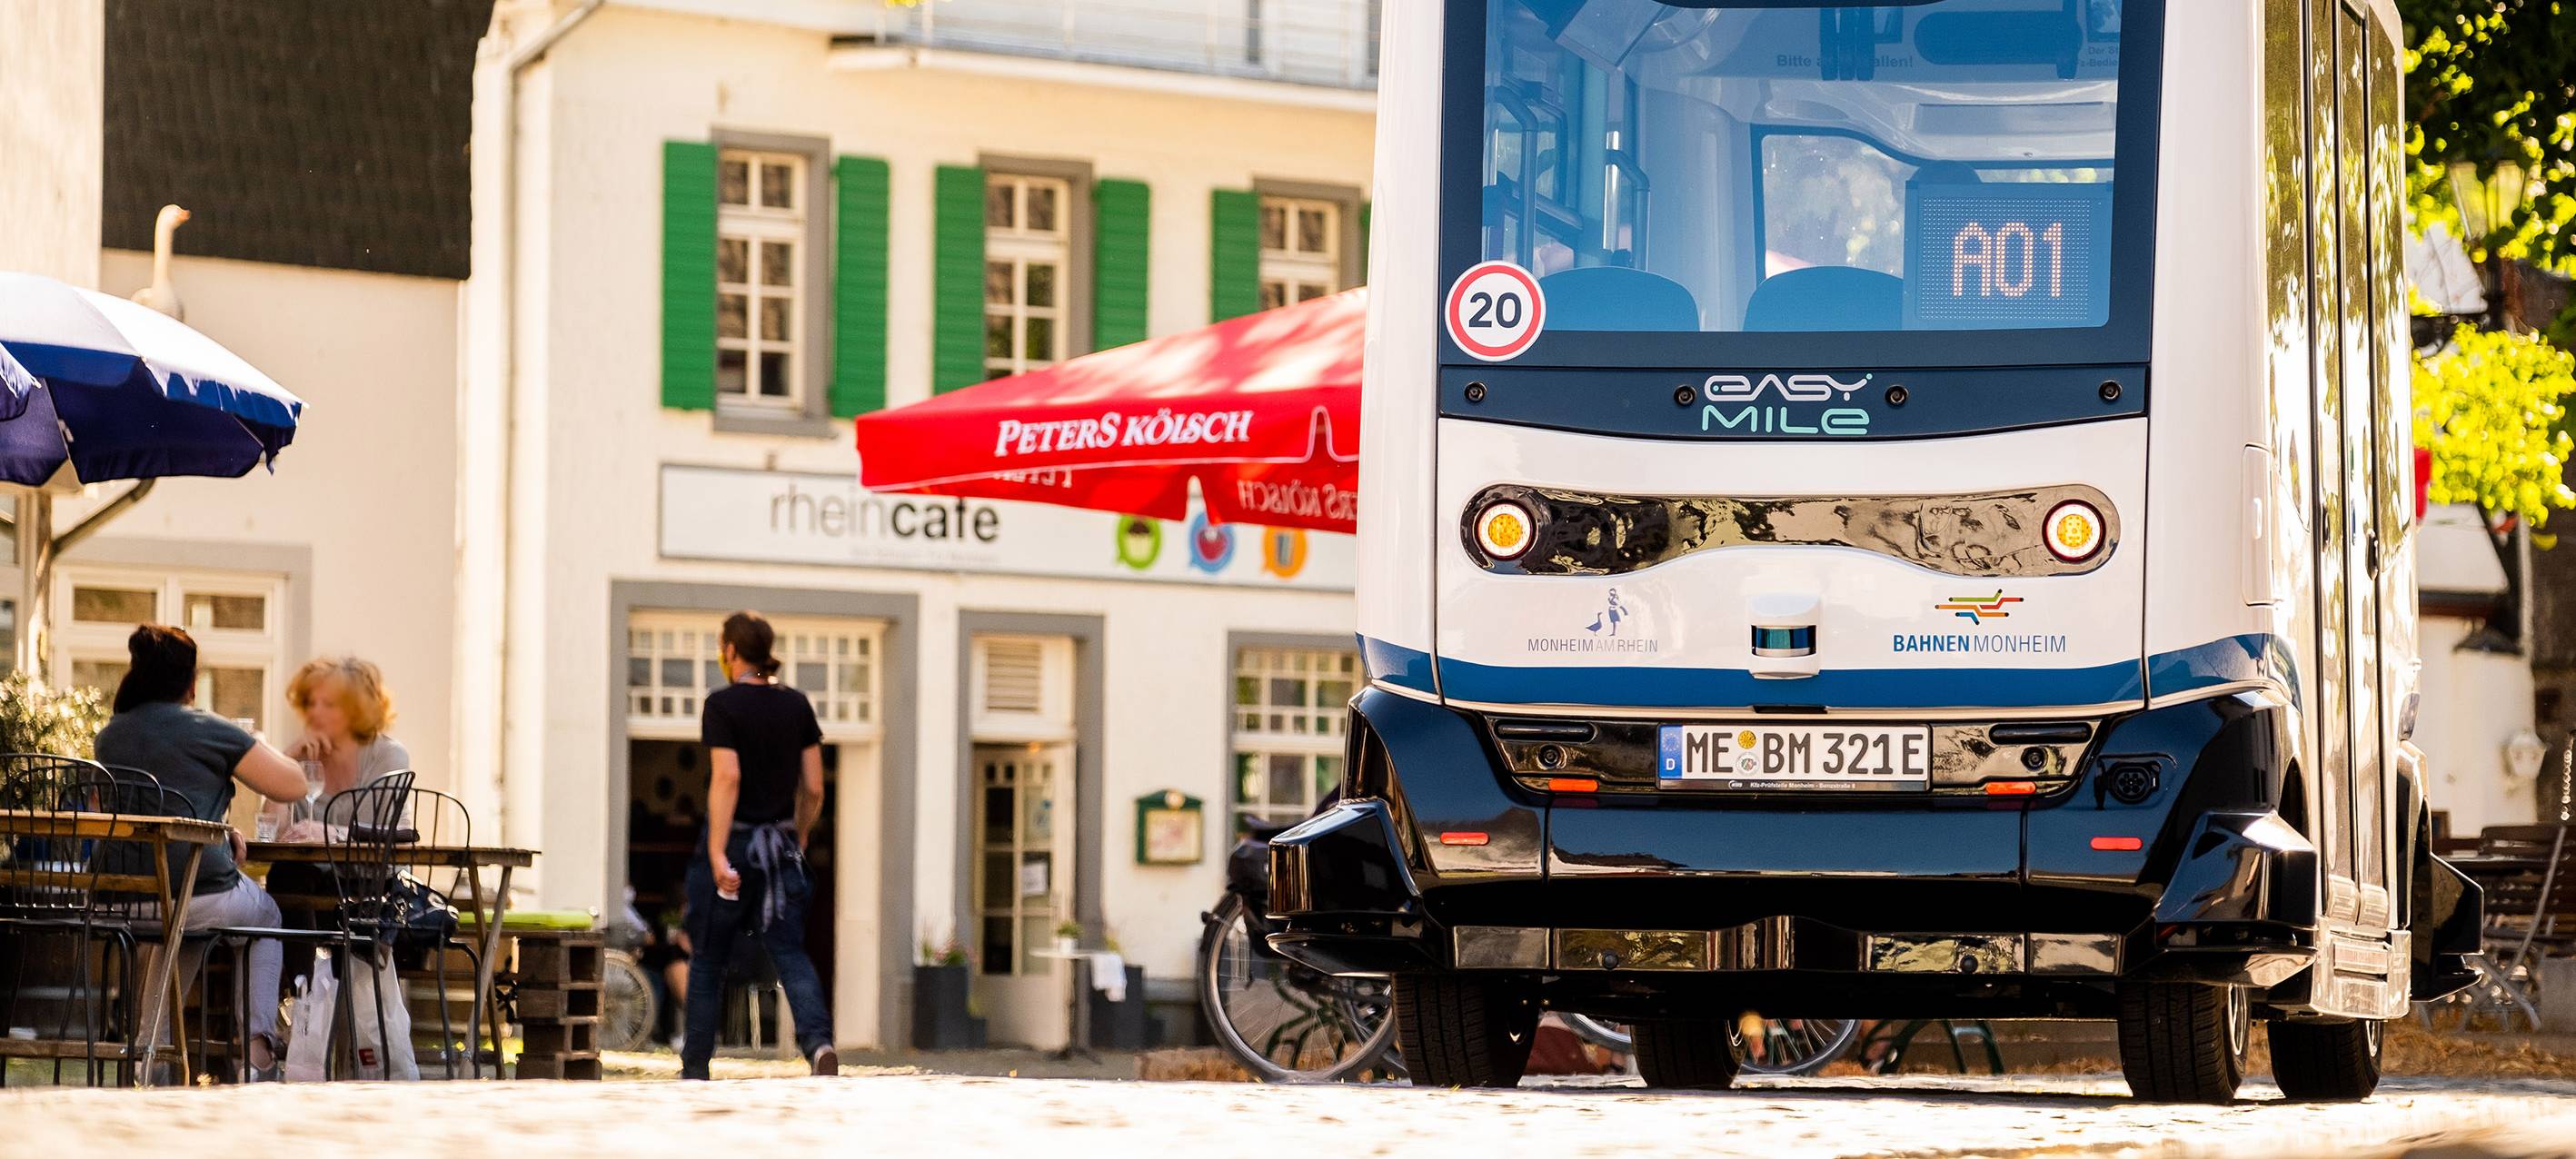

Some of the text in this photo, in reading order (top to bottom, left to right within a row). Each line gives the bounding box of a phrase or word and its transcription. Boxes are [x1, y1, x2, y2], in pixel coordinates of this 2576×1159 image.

[1953, 222, 2063, 298] A01
[1468, 292, 1522, 329] 20
[1121, 407, 1254, 446] KÖLSCH
[1666, 758, 1676, 770] D
[1686, 732, 1733, 773] ME
[1763, 733, 1811, 774] BM
